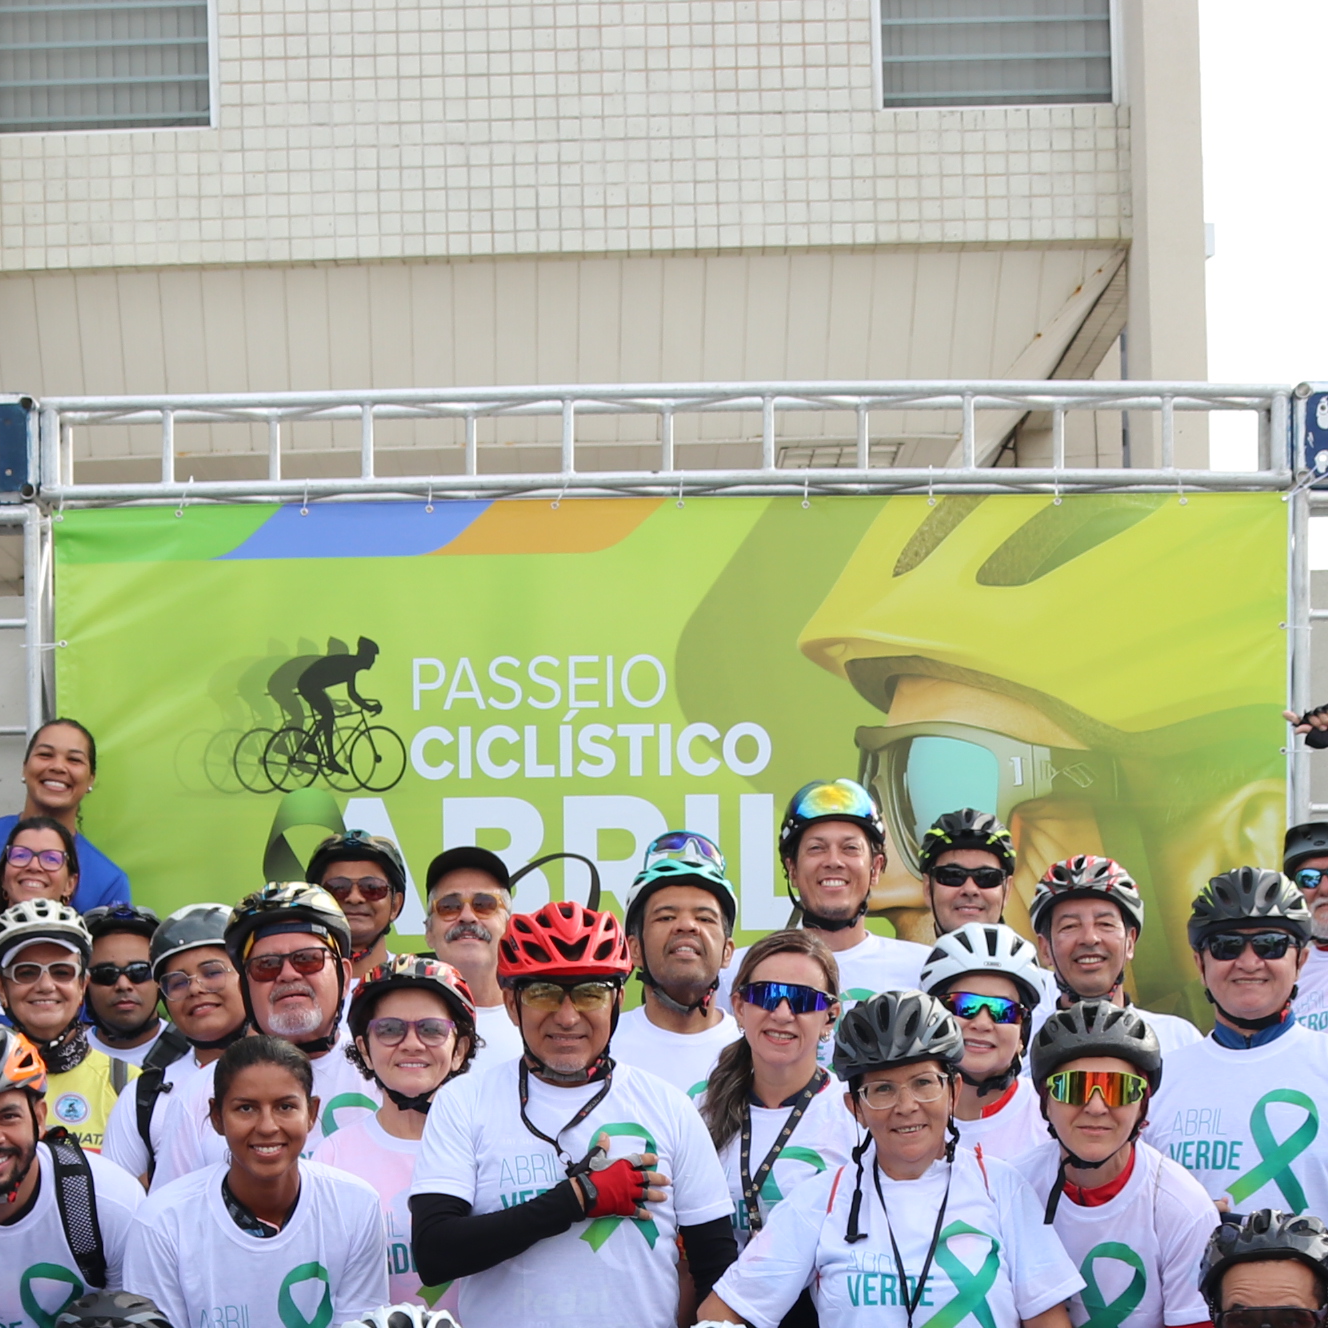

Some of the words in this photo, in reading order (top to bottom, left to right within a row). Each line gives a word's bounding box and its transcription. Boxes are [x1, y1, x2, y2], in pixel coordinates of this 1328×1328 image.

[411, 653, 667, 710] PASSEIO
[409, 709, 772, 780] CICLÍSTICO
[1172, 1106, 1227, 1136] ABRIL
[499, 1153, 569, 1188] ABRIL
[1170, 1139, 1243, 1171] VERDE
[846, 1274, 934, 1308] VERDE
